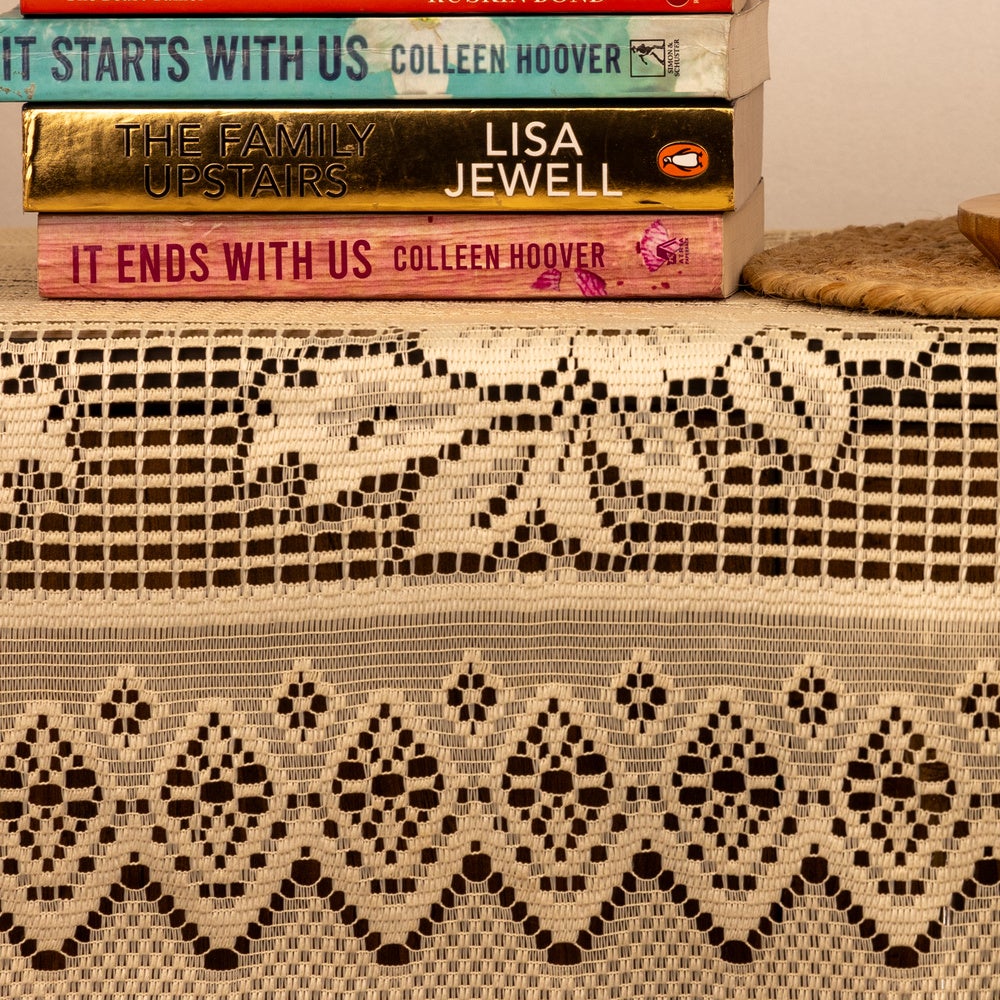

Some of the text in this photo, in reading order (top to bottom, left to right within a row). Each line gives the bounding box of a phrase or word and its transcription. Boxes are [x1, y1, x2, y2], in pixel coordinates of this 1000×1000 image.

[2, 34, 368, 82] IT STARTS WITH US
[390, 43, 621, 75] COLLEEN HOOVER
[114, 122, 376, 158] THE FAMILY
[486, 121, 583, 157] LISA
[143, 163, 348, 199] UPSTAIRS
[444, 162, 623, 197] JEWELL
[72, 239, 373, 284] IT ENDS WITH US
[393, 242, 605, 271] COLLEEN HOOVER
